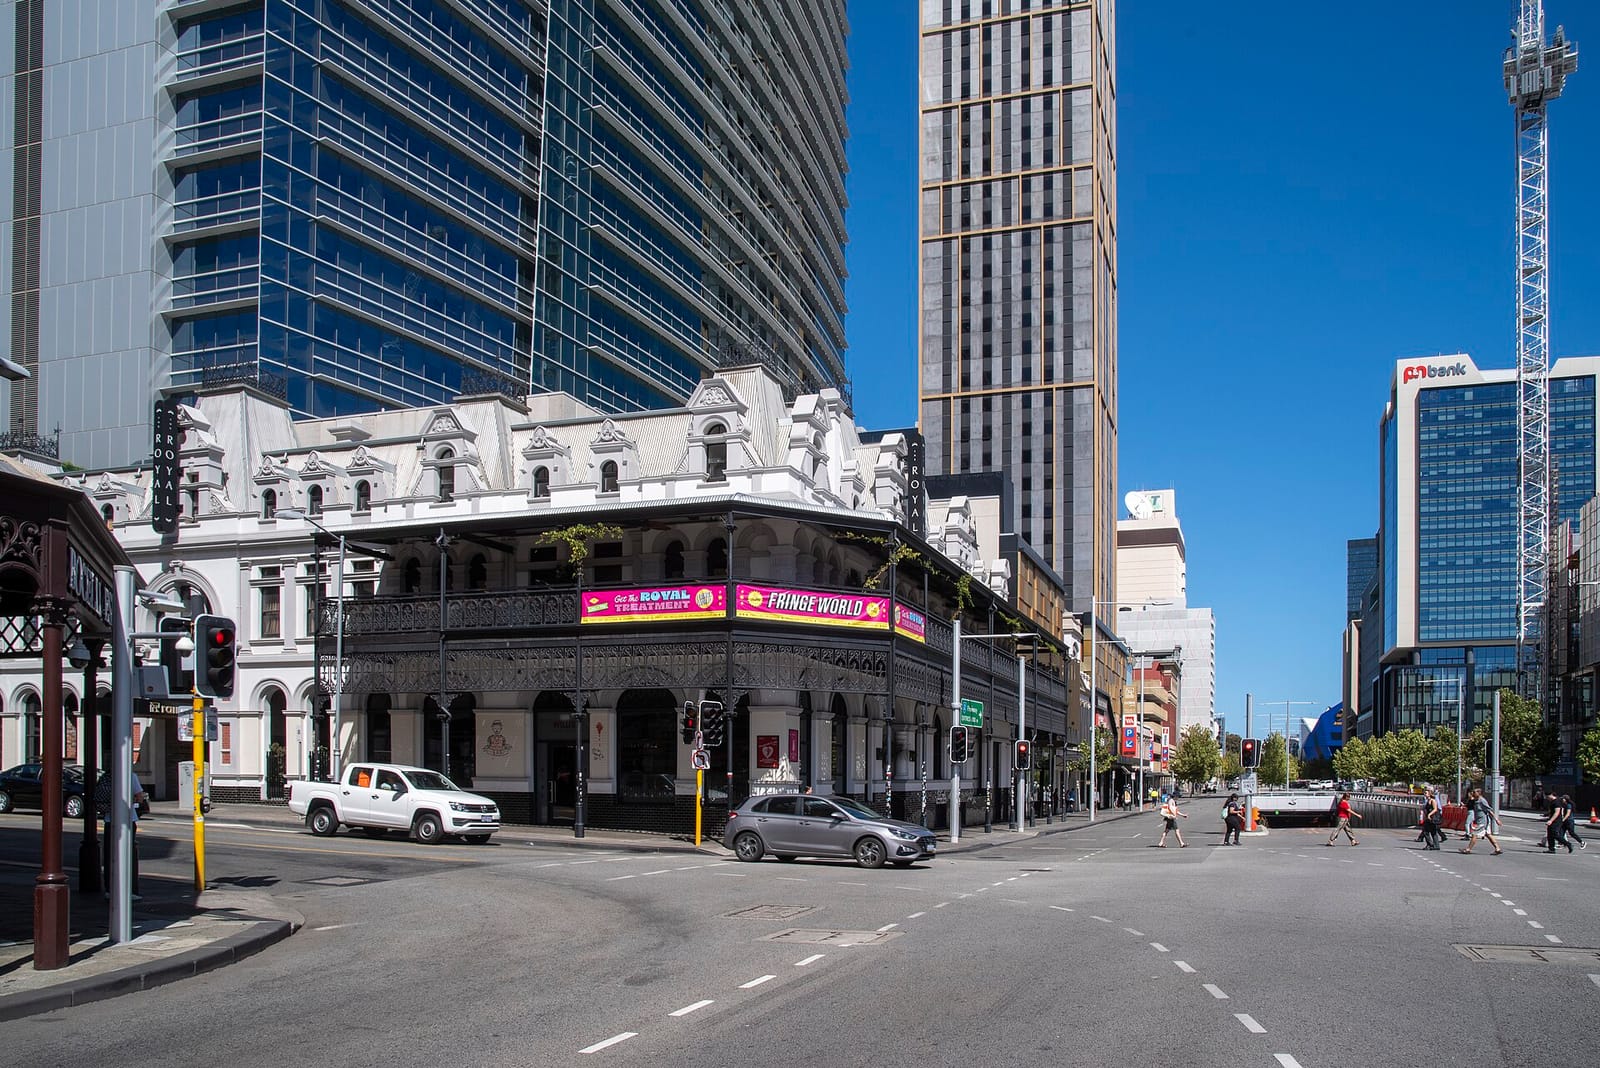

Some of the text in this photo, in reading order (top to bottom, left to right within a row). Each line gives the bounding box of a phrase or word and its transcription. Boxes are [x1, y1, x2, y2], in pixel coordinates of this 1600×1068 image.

[1427, 362, 1466, 378] bank
[165, 435, 174, 505] ROYAL
[910, 466, 919, 532] ROYAL
[614, 594, 628, 604] Get
[640, 589, 691, 602] ROYAL
[614, 600, 691, 612] TREATMENT
[767, 592, 864, 616] FRINGE WORLD
